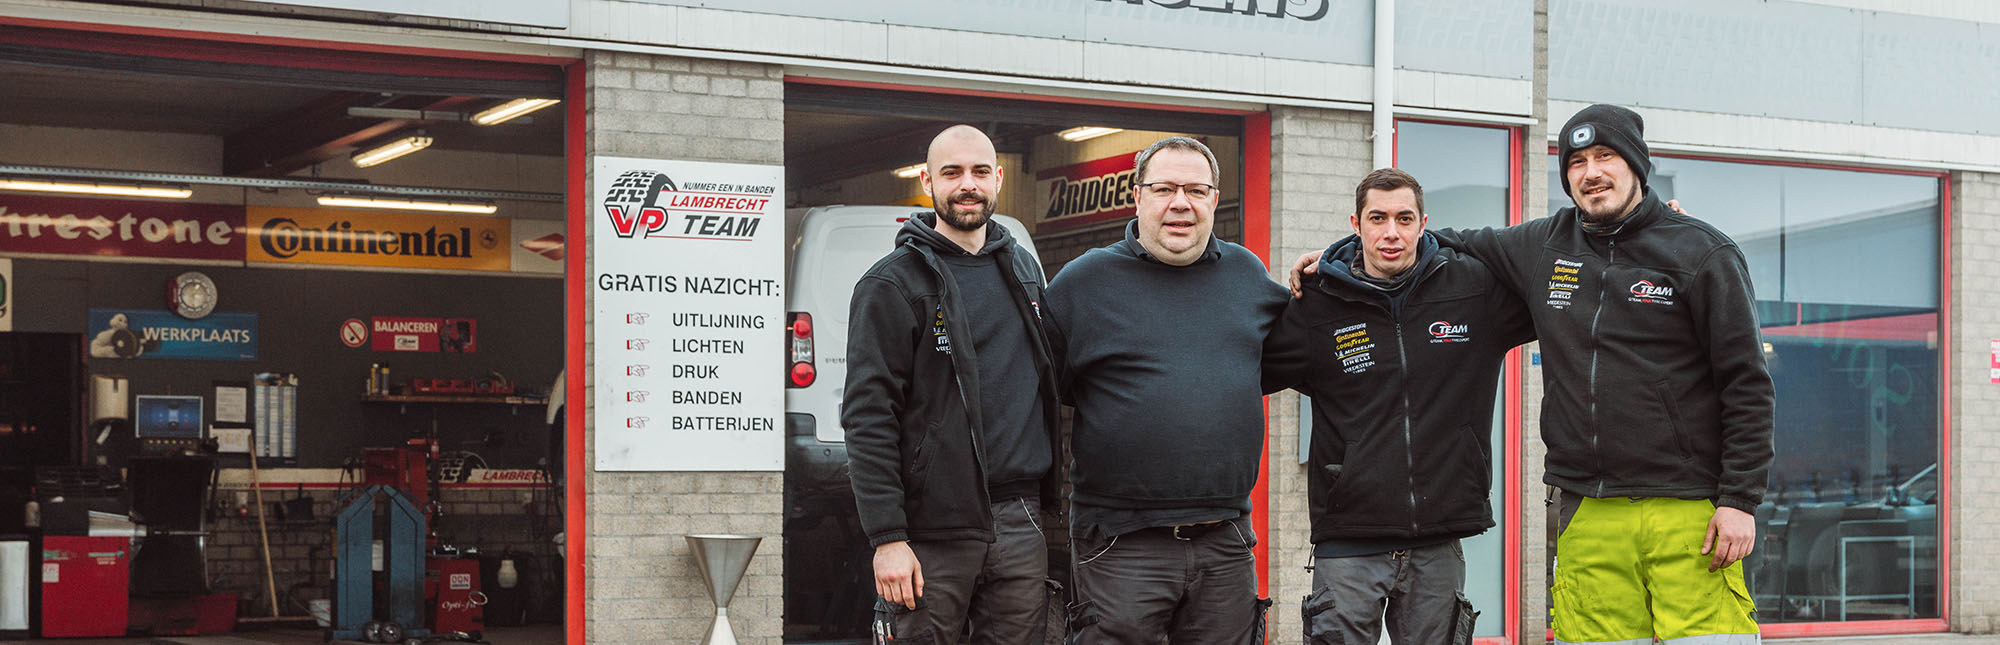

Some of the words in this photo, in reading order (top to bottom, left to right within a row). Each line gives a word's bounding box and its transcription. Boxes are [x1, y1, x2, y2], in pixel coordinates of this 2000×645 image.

[682, 182, 716, 192] NUMMER
[718, 184, 733, 192] EEN
[735, 184, 743, 193] IN
[744, 185, 775, 194] BANDEN
[670, 195, 768, 211] LAMBRECHT
[604, 205, 668, 239] VP
[683, 214, 760, 237] TEAM
[260, 217, 472, 258] Continental
[598, 273, 677, 292] GRATIS
[685, 276, 780, 297] NAZICHT:
[374, 321, 438, 333] BALANCEREN
[672, 313, 765, 329] UITLIJNING
[142, 327, 250, 343] WERKPLAATS
[672, 339, 744, 354] LICHTEN
[672, 365, 719, 379] DRUK
[672, 391, 742, 405] BANDEN
[672, 416, 773, 431] BATTERIJEN
